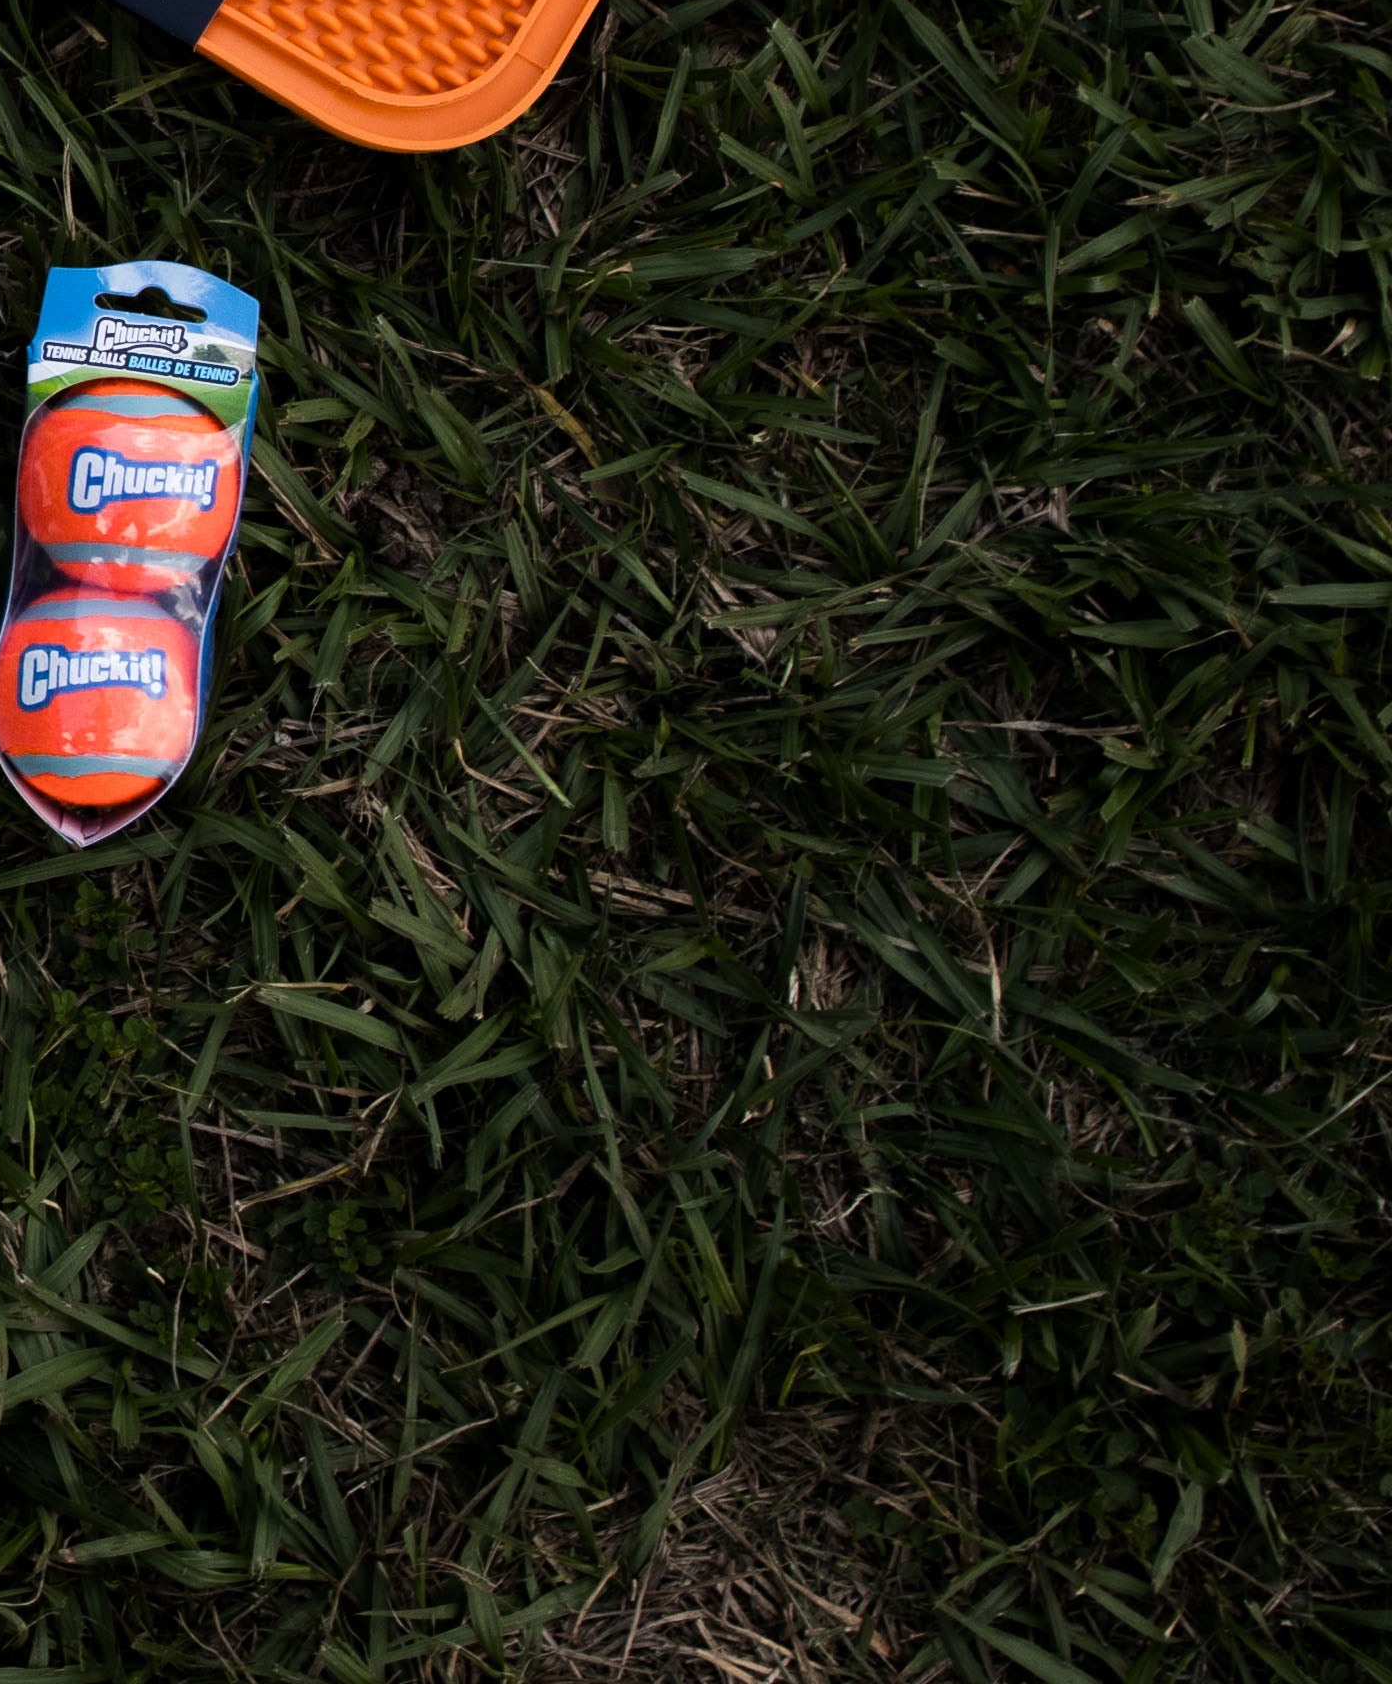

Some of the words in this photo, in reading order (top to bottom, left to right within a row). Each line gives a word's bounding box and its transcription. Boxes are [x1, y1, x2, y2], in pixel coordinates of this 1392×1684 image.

[96, 319, 185, 353] Chuckit!
[45, 345, 87, 362] TENNIS
[89, 353, 127, 367] BALLS
[128, 356, 172, 374] BALLES
[175, 362, 191, 376] DE
[193, 365, 237, 383] TENNIS
[72, 452, 215, 508] Chuckit!
[21, 649, 162, 705] Chuckit!
